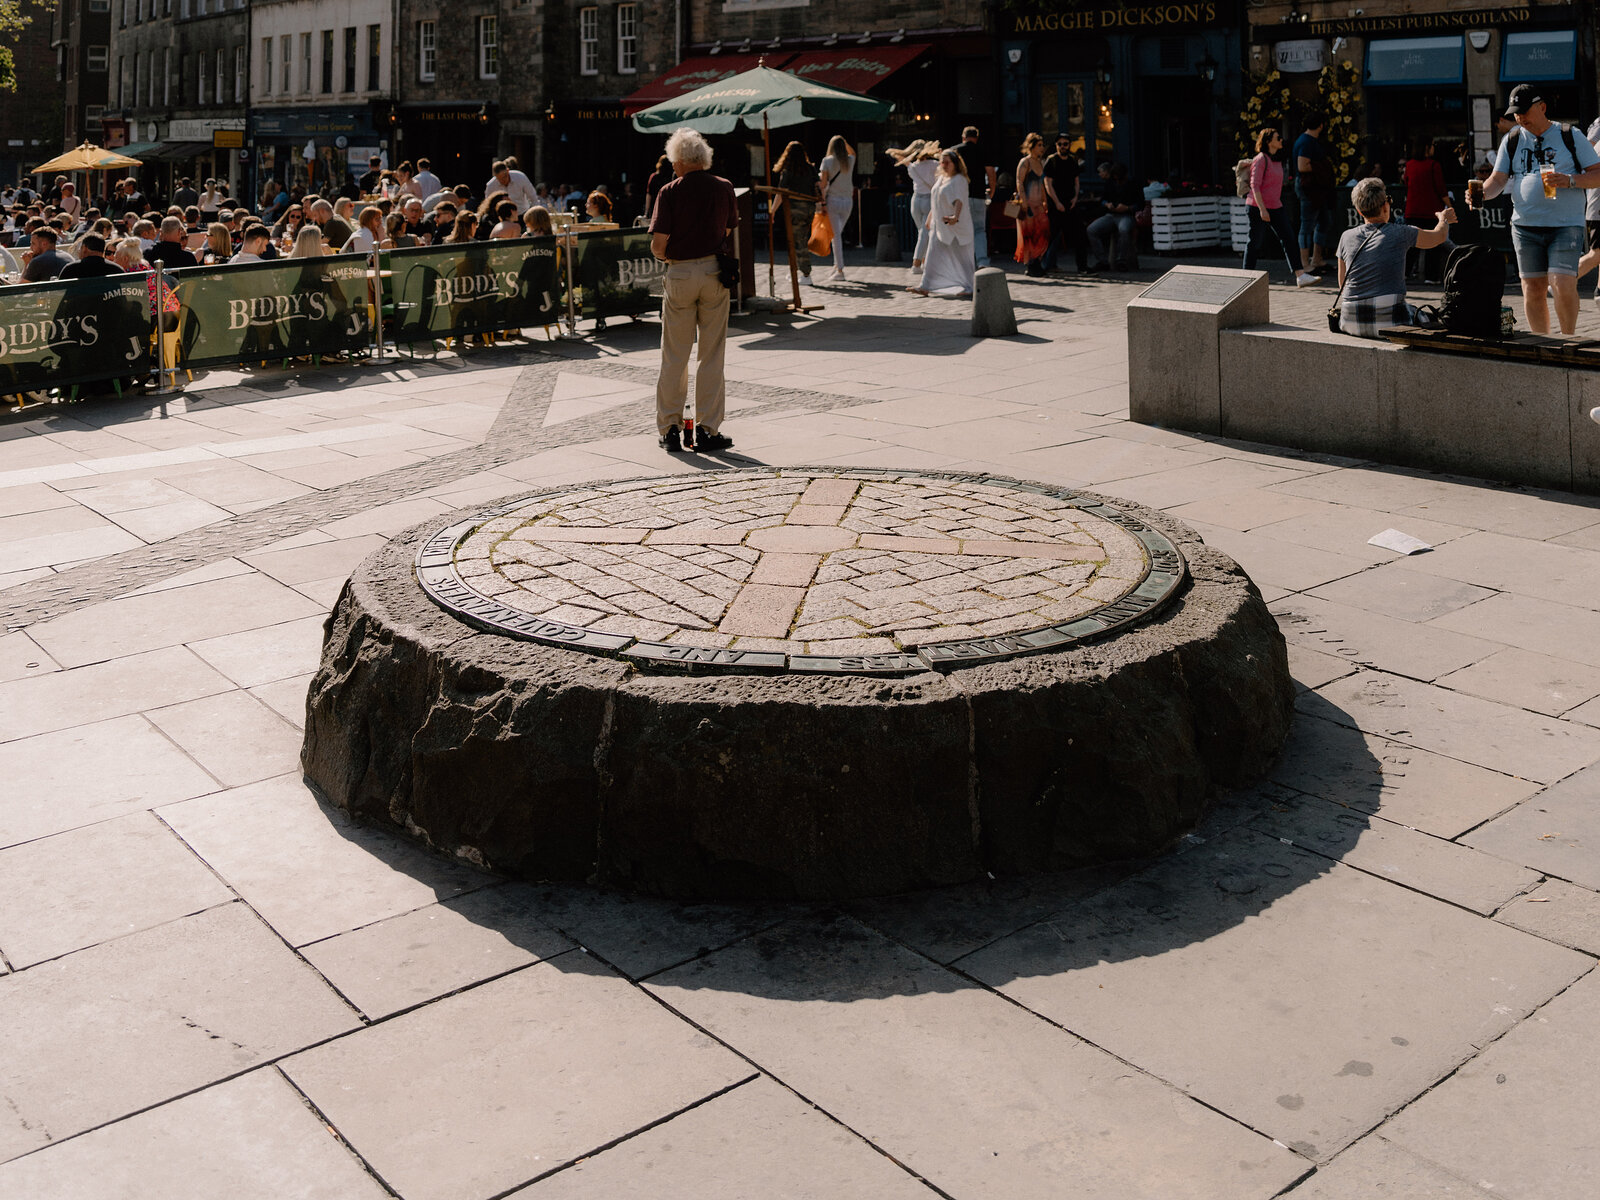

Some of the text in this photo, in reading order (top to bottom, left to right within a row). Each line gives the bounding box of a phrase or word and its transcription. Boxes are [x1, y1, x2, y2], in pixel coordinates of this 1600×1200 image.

[1014, 2, 1217, 32] MAGGIE DICKSON'S
[1309, 8, 1531, 36] THE SMALLEST PUB IN SCOTLAND
[836, 57, 893, 75] Bistro
[437, 111, 456, 121] LAST
[577, 108, 595, 121] THE
[597, 108, 620, 121] LAST
[521, 248, 554, 261] JAMESON
[328, 266, 365, 279] JAMESON
[102, 287, 145, 302] JAMESON
[434, 270, 520, 308] BIDDY'S
[227, 291, 326, 331] BIDDY'S
[539, 290, 554, 313] J
[346, 312, 362, 336] J
[125, 335, 144, 361] J
[427, 576, 588, 643] COVENANTERS
[1087, 592, 1158, 627] MANY
[661, 645, 748, 665] AND
